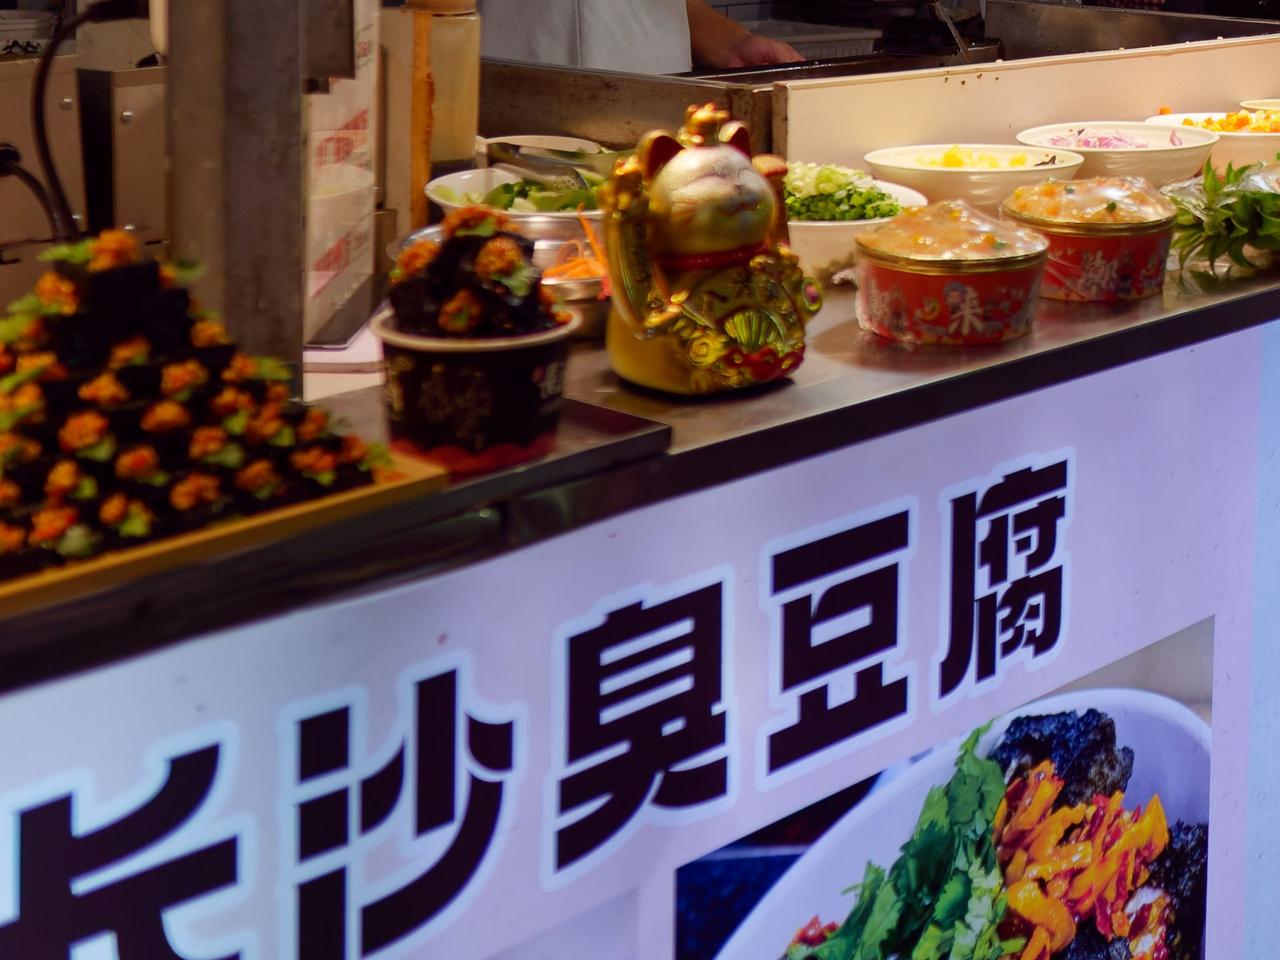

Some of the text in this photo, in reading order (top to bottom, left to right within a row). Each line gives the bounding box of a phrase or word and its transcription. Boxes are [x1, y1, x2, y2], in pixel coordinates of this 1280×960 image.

[0, 458, 1069, 960] 长沙臭豆腐
